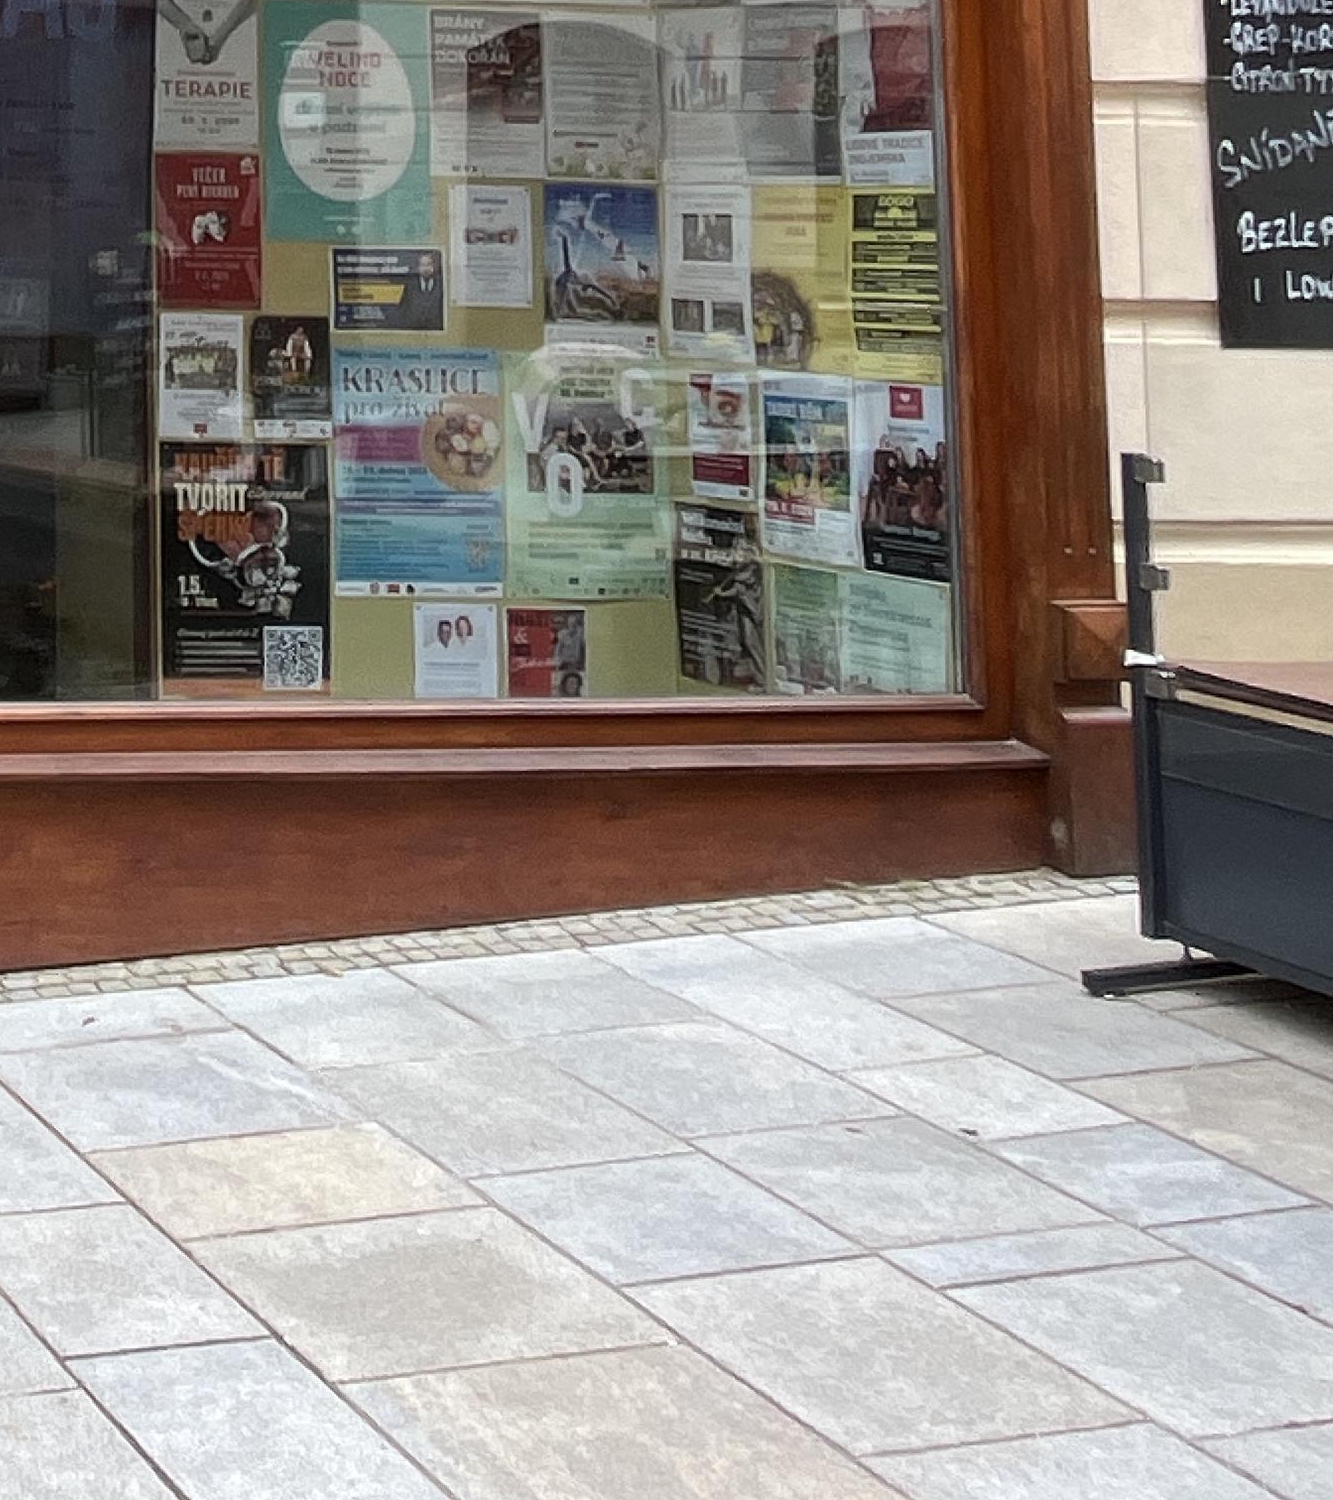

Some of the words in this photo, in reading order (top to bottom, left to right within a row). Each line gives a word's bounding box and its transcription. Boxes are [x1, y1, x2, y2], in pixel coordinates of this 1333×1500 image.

[159, 79, 253, 99] TERAPIE
[882, 137, 925, 150] TRADICE
[342, 366, 485, 394] KRASLICE
[173, 476, 249, 512] TVOŘIT
